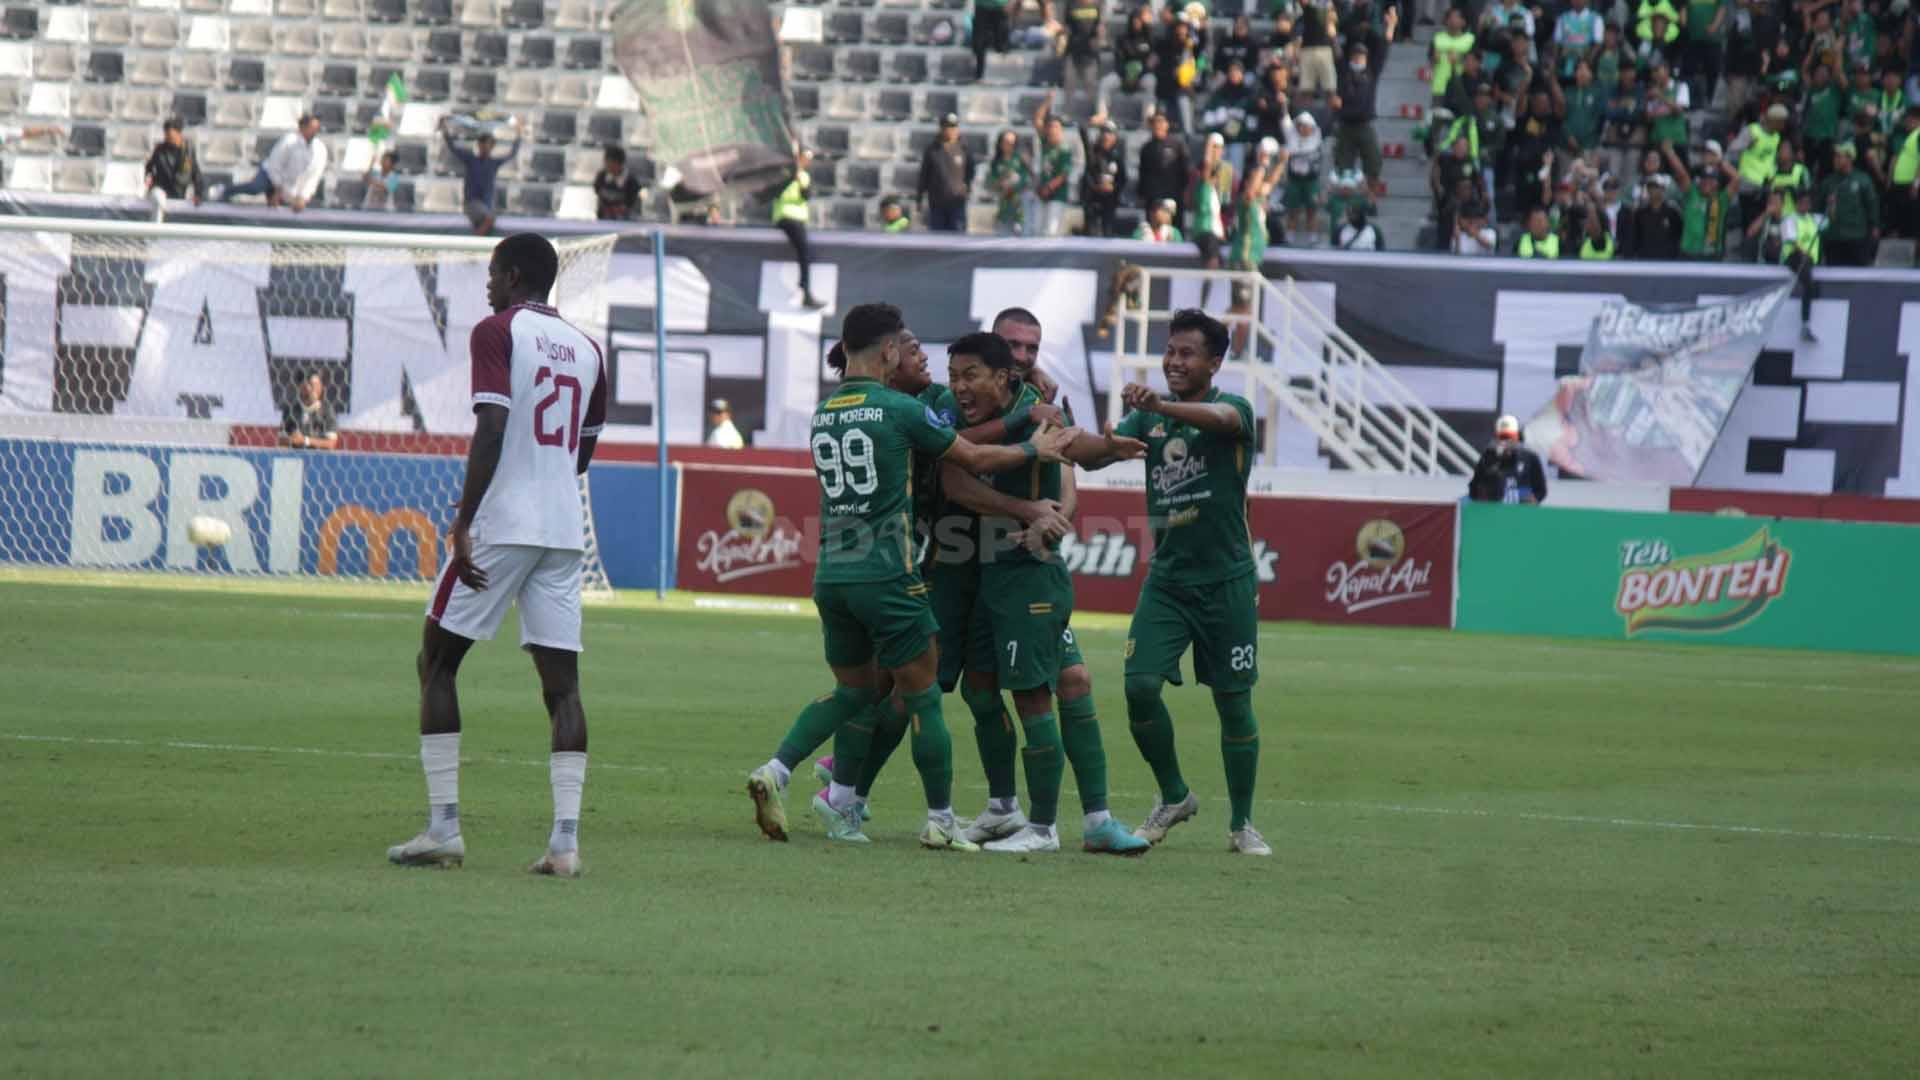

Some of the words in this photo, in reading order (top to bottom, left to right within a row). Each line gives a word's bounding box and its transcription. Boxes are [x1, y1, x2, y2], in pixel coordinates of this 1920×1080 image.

[812, 413, 835, 428] RUNO
[839, 407, 883, 425] MOREIRA
[813, 428, 878, 498] 99
[1059, 530, 1137, 577] bih
[1622, 540, 1671, 568] Teh
[1325, 560, 1392, 605] Kapal
[1387, 557, 1433, 593] Api
[1617, 551, 1789, 613] BONTEH
[1007, 639, 1018, 668] 7
[1231, 644, 1255, 671] 23
